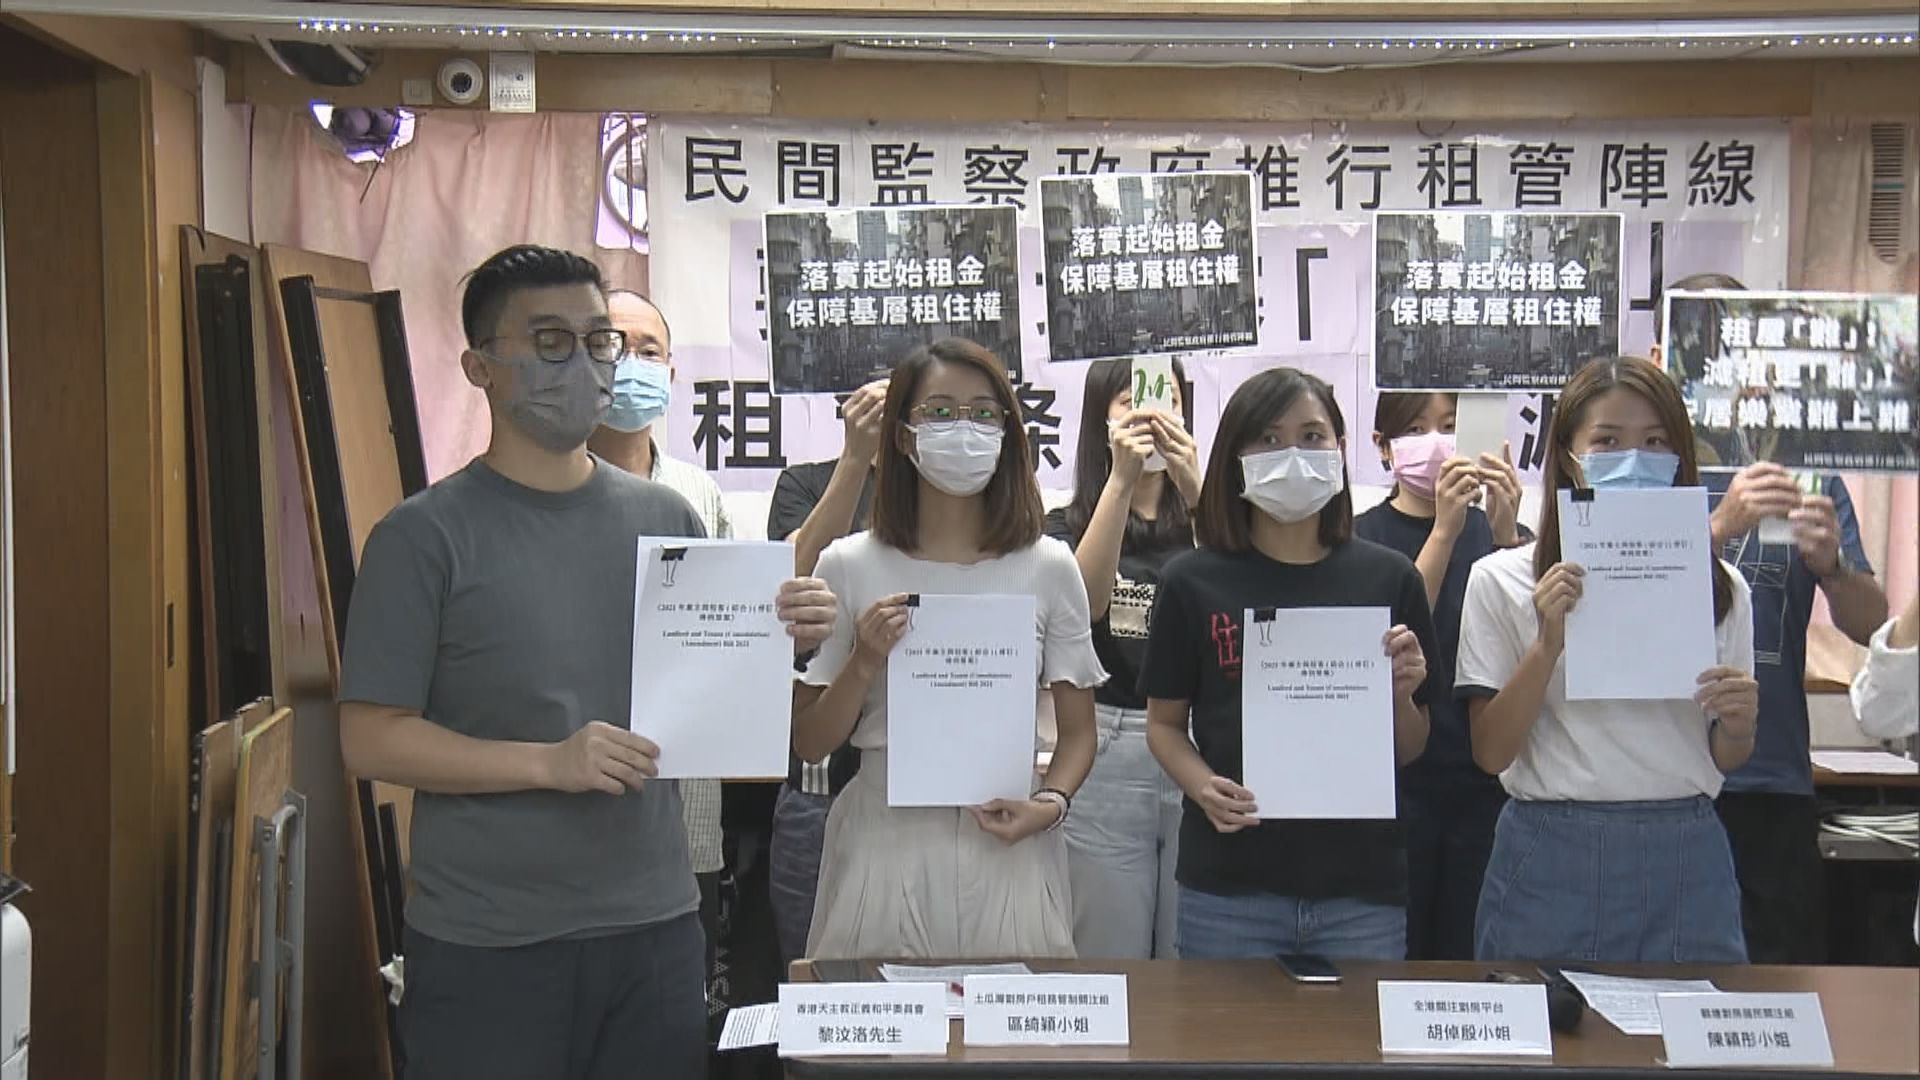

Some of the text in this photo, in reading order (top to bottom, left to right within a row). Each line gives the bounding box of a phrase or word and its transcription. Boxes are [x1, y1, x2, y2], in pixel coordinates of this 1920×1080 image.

[1071, 218, 1225, 257] 落實起始租金
[801, 255, 985, 292] 落實起始租金
[1060, 254, 1240, 295] 保障基層租住權
[1406, 260, 1587, 291] 落實起始租金
[786, 291, 1003, 329] 保障基層租住權
[1390, 296, 1602, 326] 保障基層租住權
[797, 1003, 925, 1016] 香港天主教正義和平委員會
[818, 1026, 902, 1043] 黎汶洛先生
